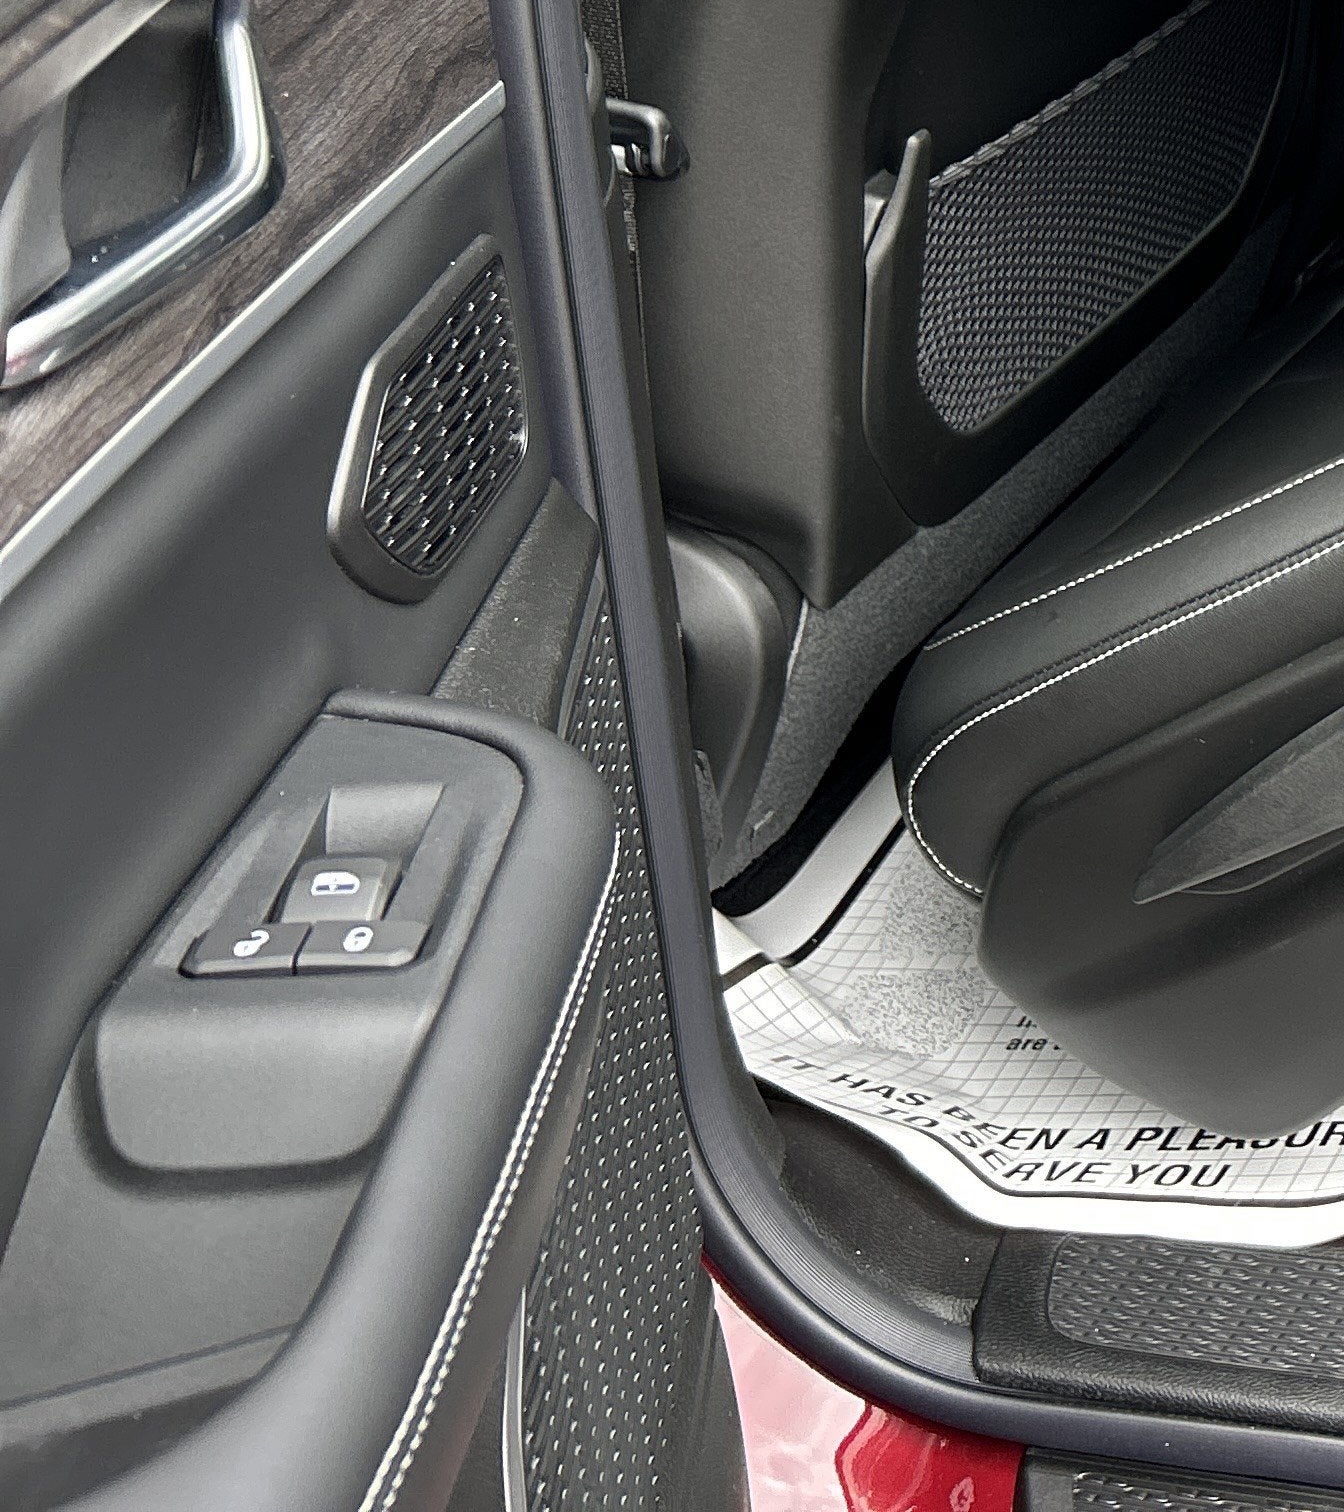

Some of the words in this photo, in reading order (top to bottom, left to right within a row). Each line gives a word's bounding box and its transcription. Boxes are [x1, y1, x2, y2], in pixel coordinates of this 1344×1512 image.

[1006, 1037, 1048, 1050] are
[771, 1054, 825, 1071] IT
[828, 1073, 933, 1107] HAS
[942, 1105, 1074, 1151] BEEN
[1073, 1128, 1111, 1151] A
[880, 1105, 940, 1128] TO
[951, 1129, 1112, 1182] SERVE
[1124, 1163, 1232, 1188] YOU
